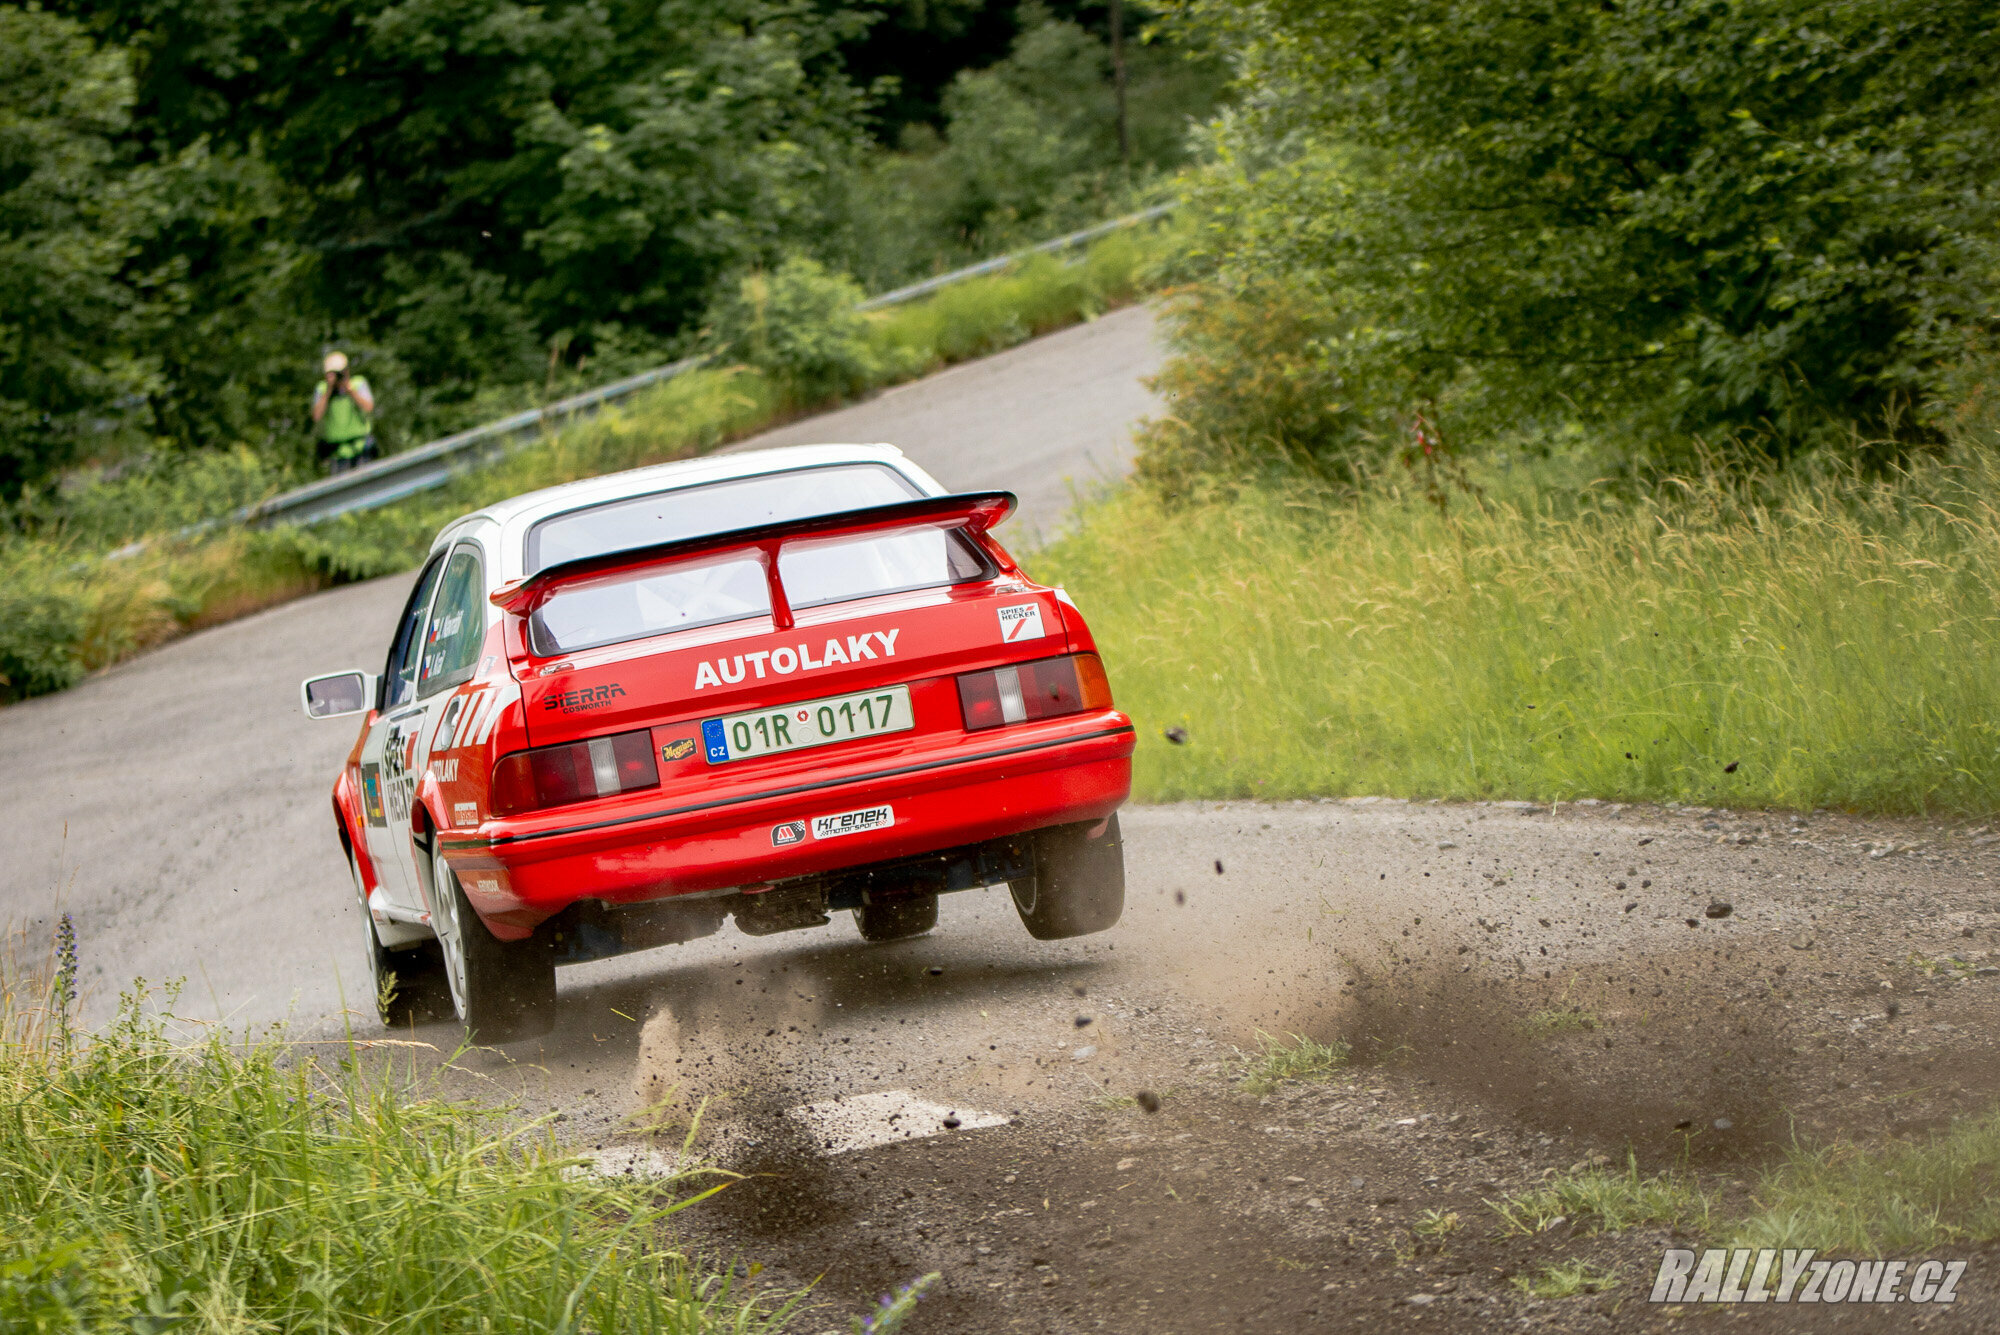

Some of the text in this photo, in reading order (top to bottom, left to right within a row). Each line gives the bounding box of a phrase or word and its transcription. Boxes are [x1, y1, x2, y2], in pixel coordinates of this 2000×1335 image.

[1000, 606, 1025, 616] SPIES
[1001, 610, 1036, 621] HECKER
[694, 628, 901, 691] AUTOLAKY
[562, 699, 613, 714] COSWORTH
[732, 694, 895, 753] 01R 0117
[710, 746, 726, 758] CZ
